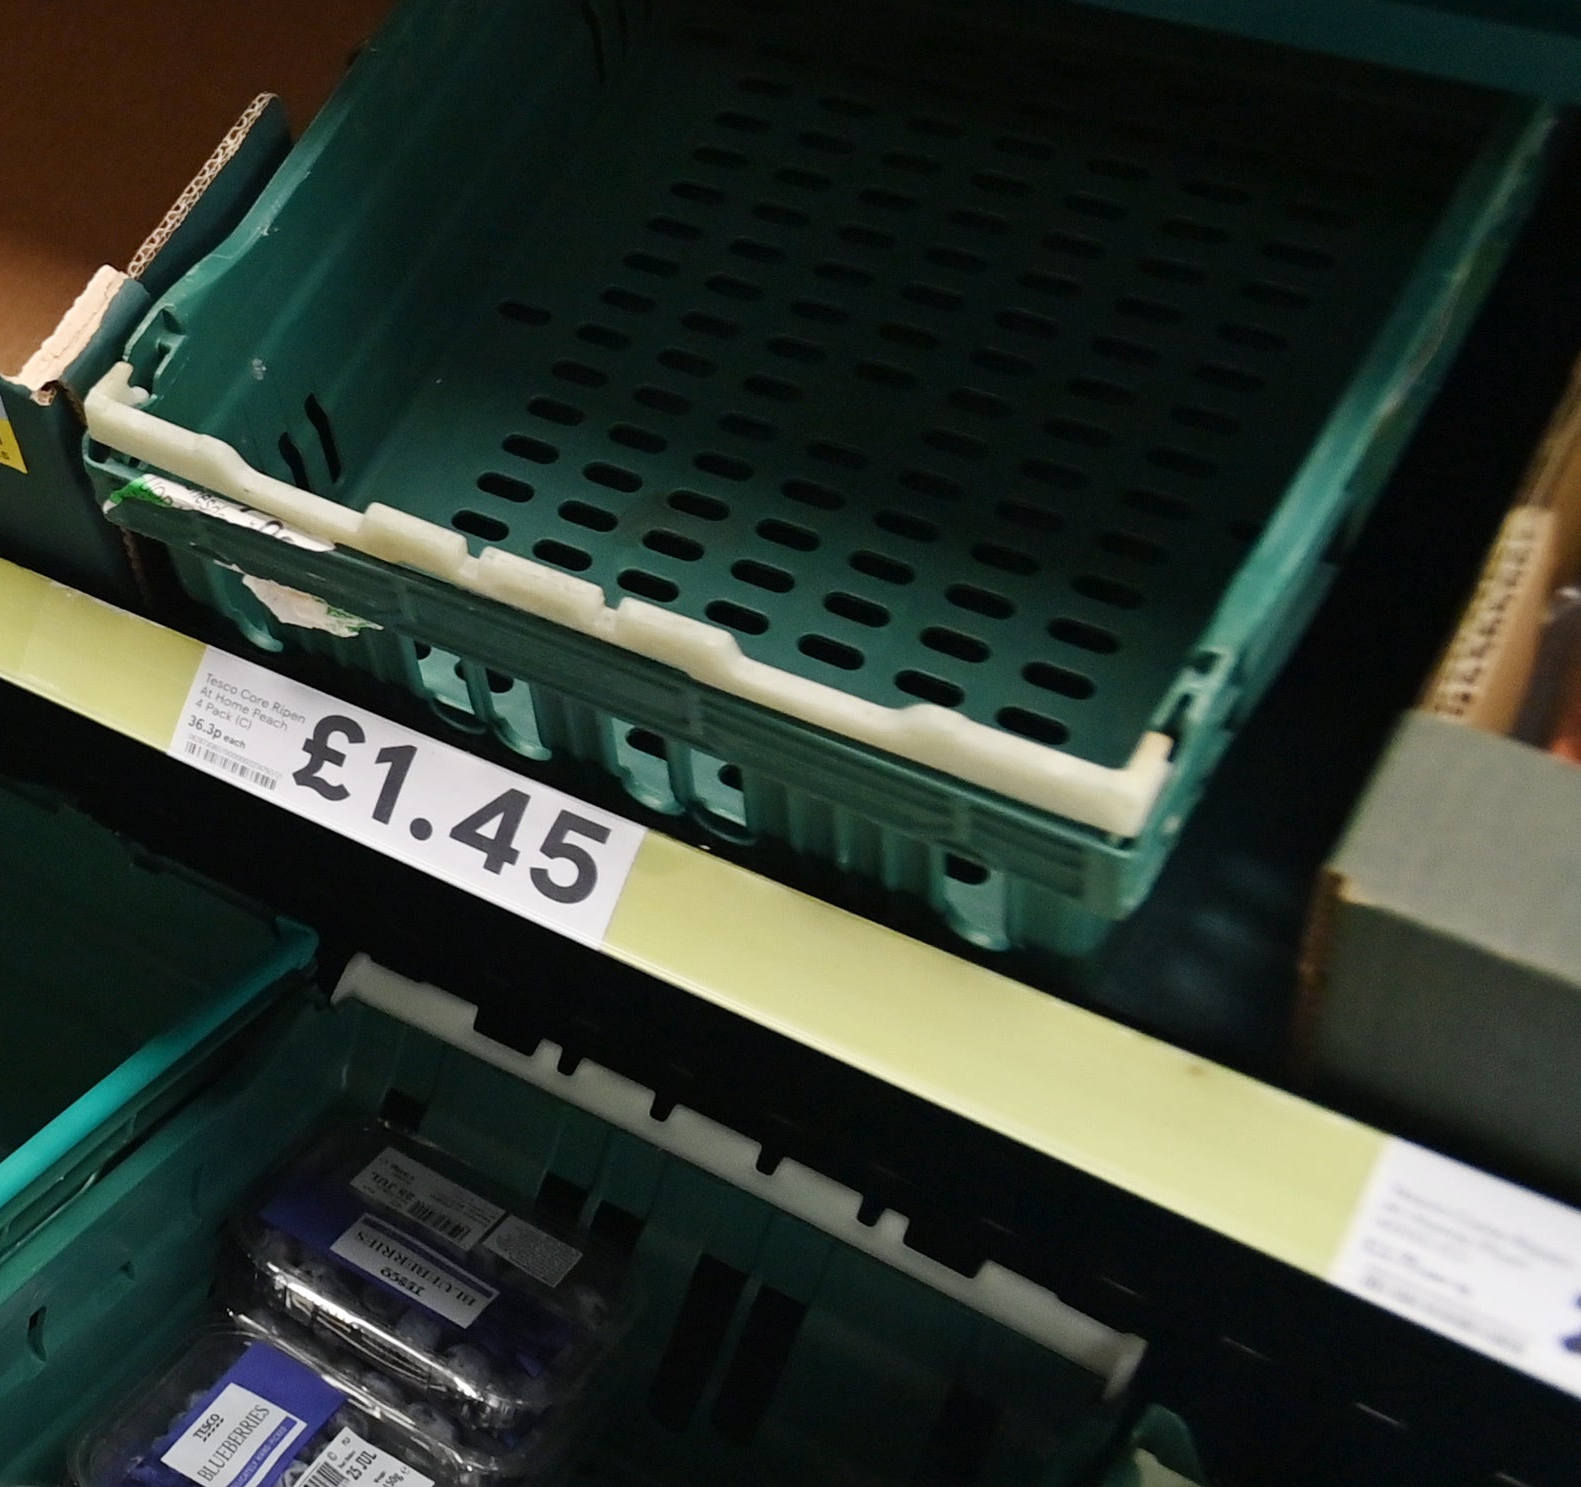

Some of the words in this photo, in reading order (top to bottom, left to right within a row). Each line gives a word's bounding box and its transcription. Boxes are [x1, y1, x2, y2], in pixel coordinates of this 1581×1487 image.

[195, 699, 203, 710] 4
[205, 703, 234, 723] Pack
[235, 716, 252, 731] (C)
[200, 686, 213, 699] At
[215, 691, 250, 715] Home
[252, 706, 288, 732] Peach
[206, 672, 238, 696] Tesco
[240, 684, 269, 707] Core
[272, 699, 306, 726] Ripen
[188, 714, 222, 740] 36.3p
[223, 732, 246, 750] each
[292, 715, 611, 904] £1.45
[357, 1231, 476, 1306] BLUEBERRIES
[380, 1267, 426, 1297] TESCO
[193, 1413, 222, 1440] TESCO
[197, 1403, 270, 1482] BLUEBERRIES
[346, 1466, 359, 1480] 25
[356, 1451, 377, 1470] JUL
